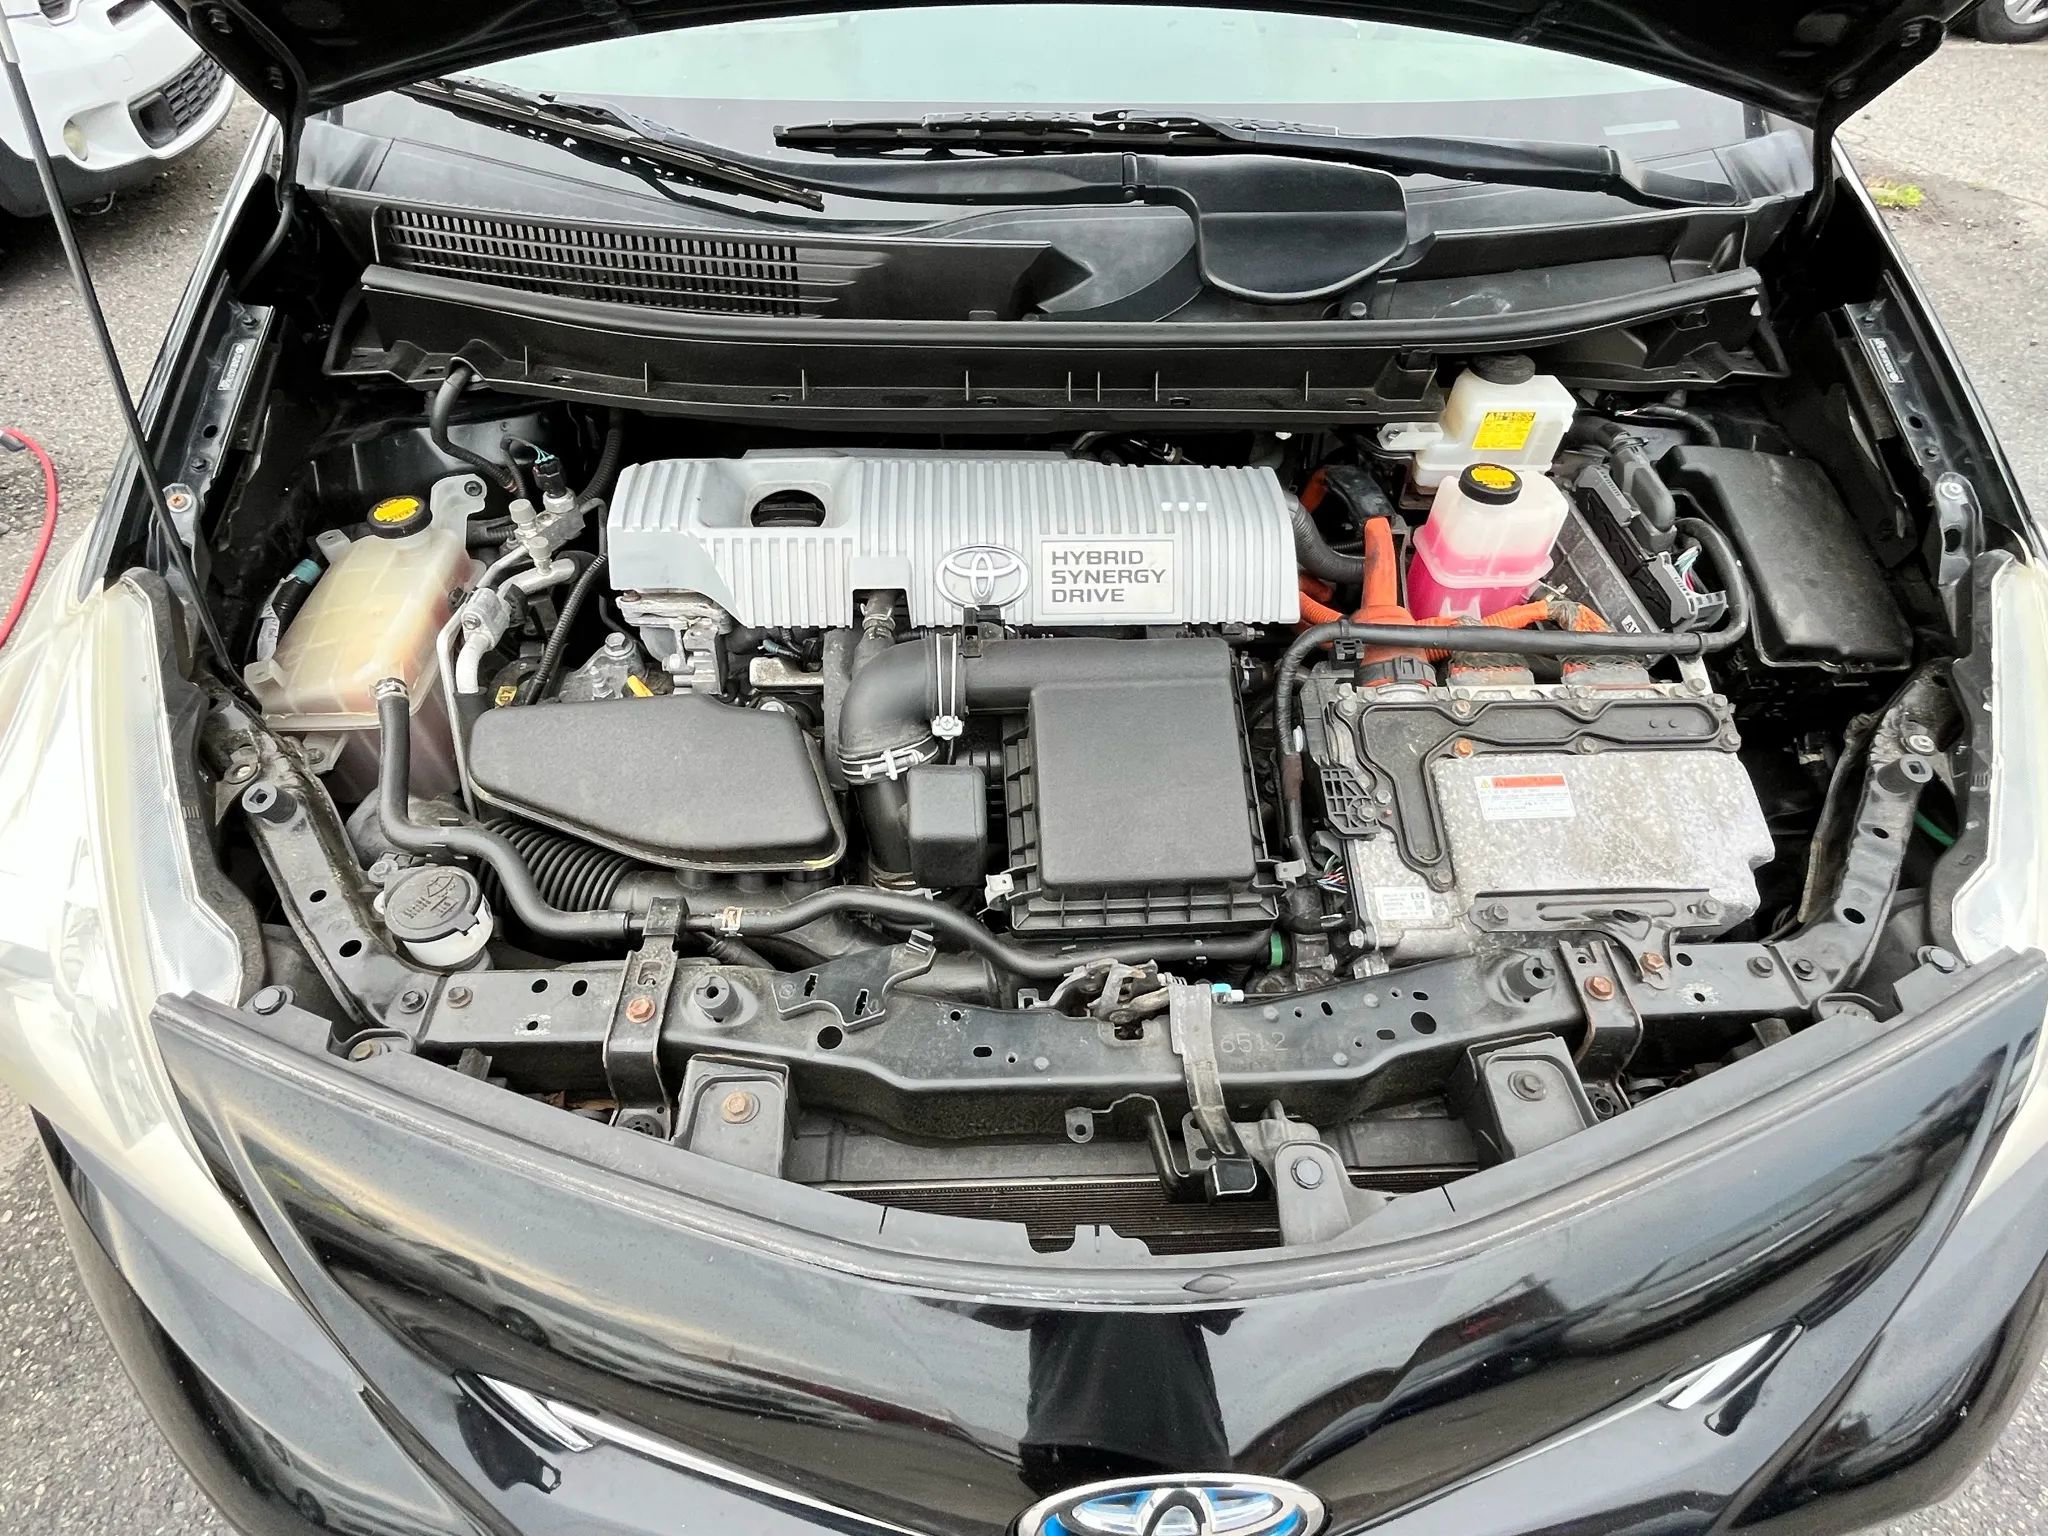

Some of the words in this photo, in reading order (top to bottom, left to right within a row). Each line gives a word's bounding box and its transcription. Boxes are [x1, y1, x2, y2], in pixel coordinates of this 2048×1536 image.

[1052, 550, 1144, 565] HYBRID
[1052, 569, 1166, 584] SYNERGY
[1052, 588, 1125, 603] DRIVE
